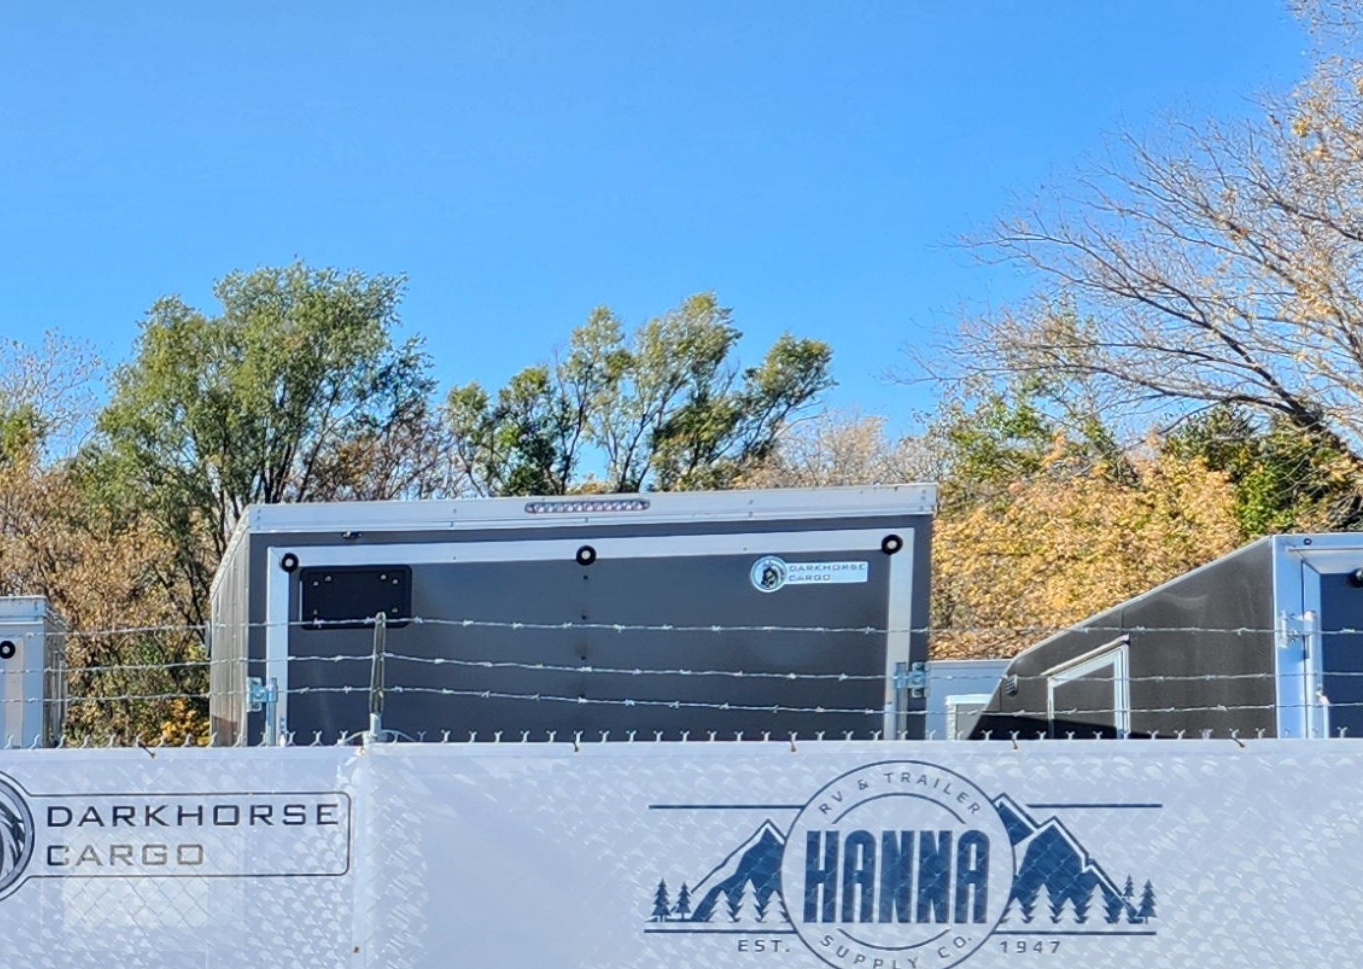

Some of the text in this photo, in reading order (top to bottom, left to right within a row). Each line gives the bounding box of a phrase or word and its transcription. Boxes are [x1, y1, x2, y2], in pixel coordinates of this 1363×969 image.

[818, 771, 981, 816] RV & TRAILER
[46, 803, 339, 828] DARKHORSE
[46, 844, 204, 867] CARGO
[802, 829, 991, 925] HANNA
[737, 938, 791, 954] EST.
[998, 940, 1062, 954] 1947
